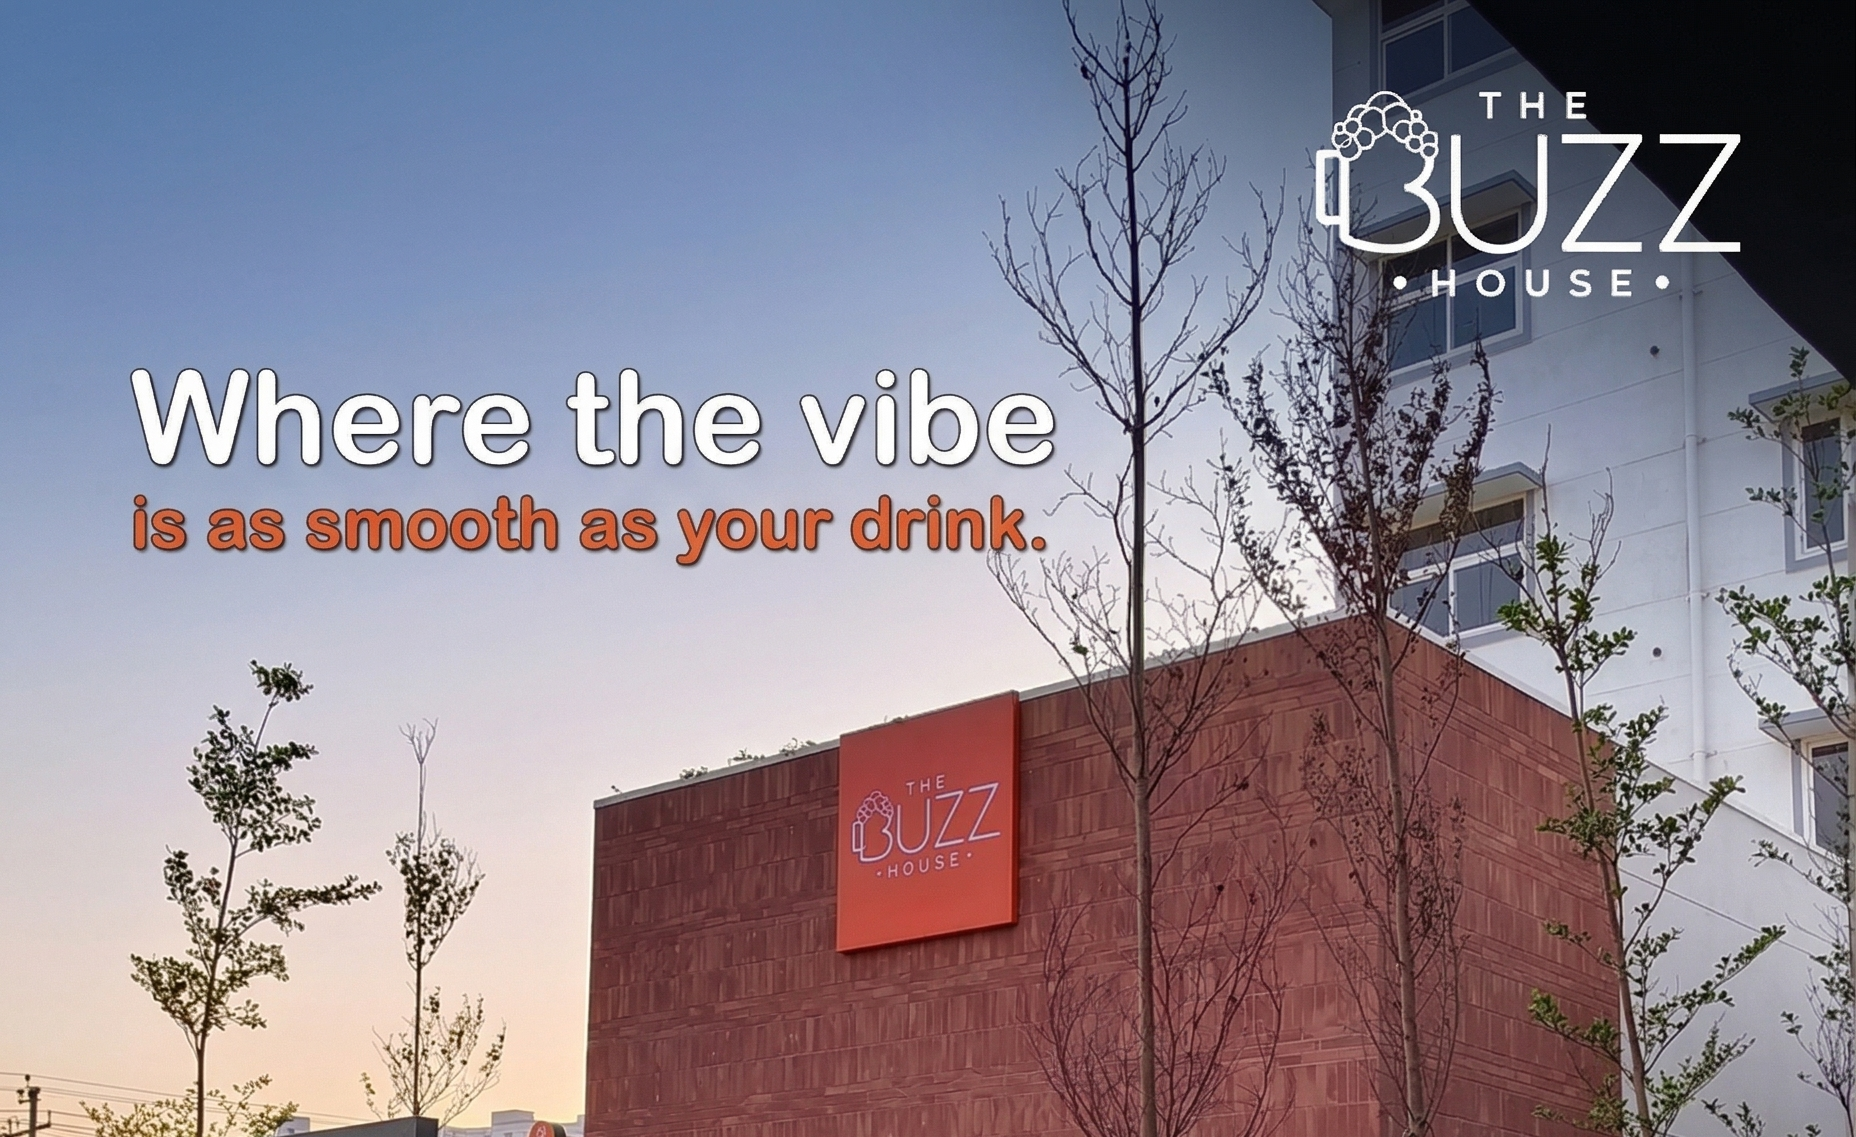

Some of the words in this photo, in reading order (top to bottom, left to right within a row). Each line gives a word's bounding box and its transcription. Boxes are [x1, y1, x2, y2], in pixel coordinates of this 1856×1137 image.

[906, 774, 946, 796] THE
[852, 782, 1001, 863] BUZZ
[887, 852, 960, 879] HOUSE
